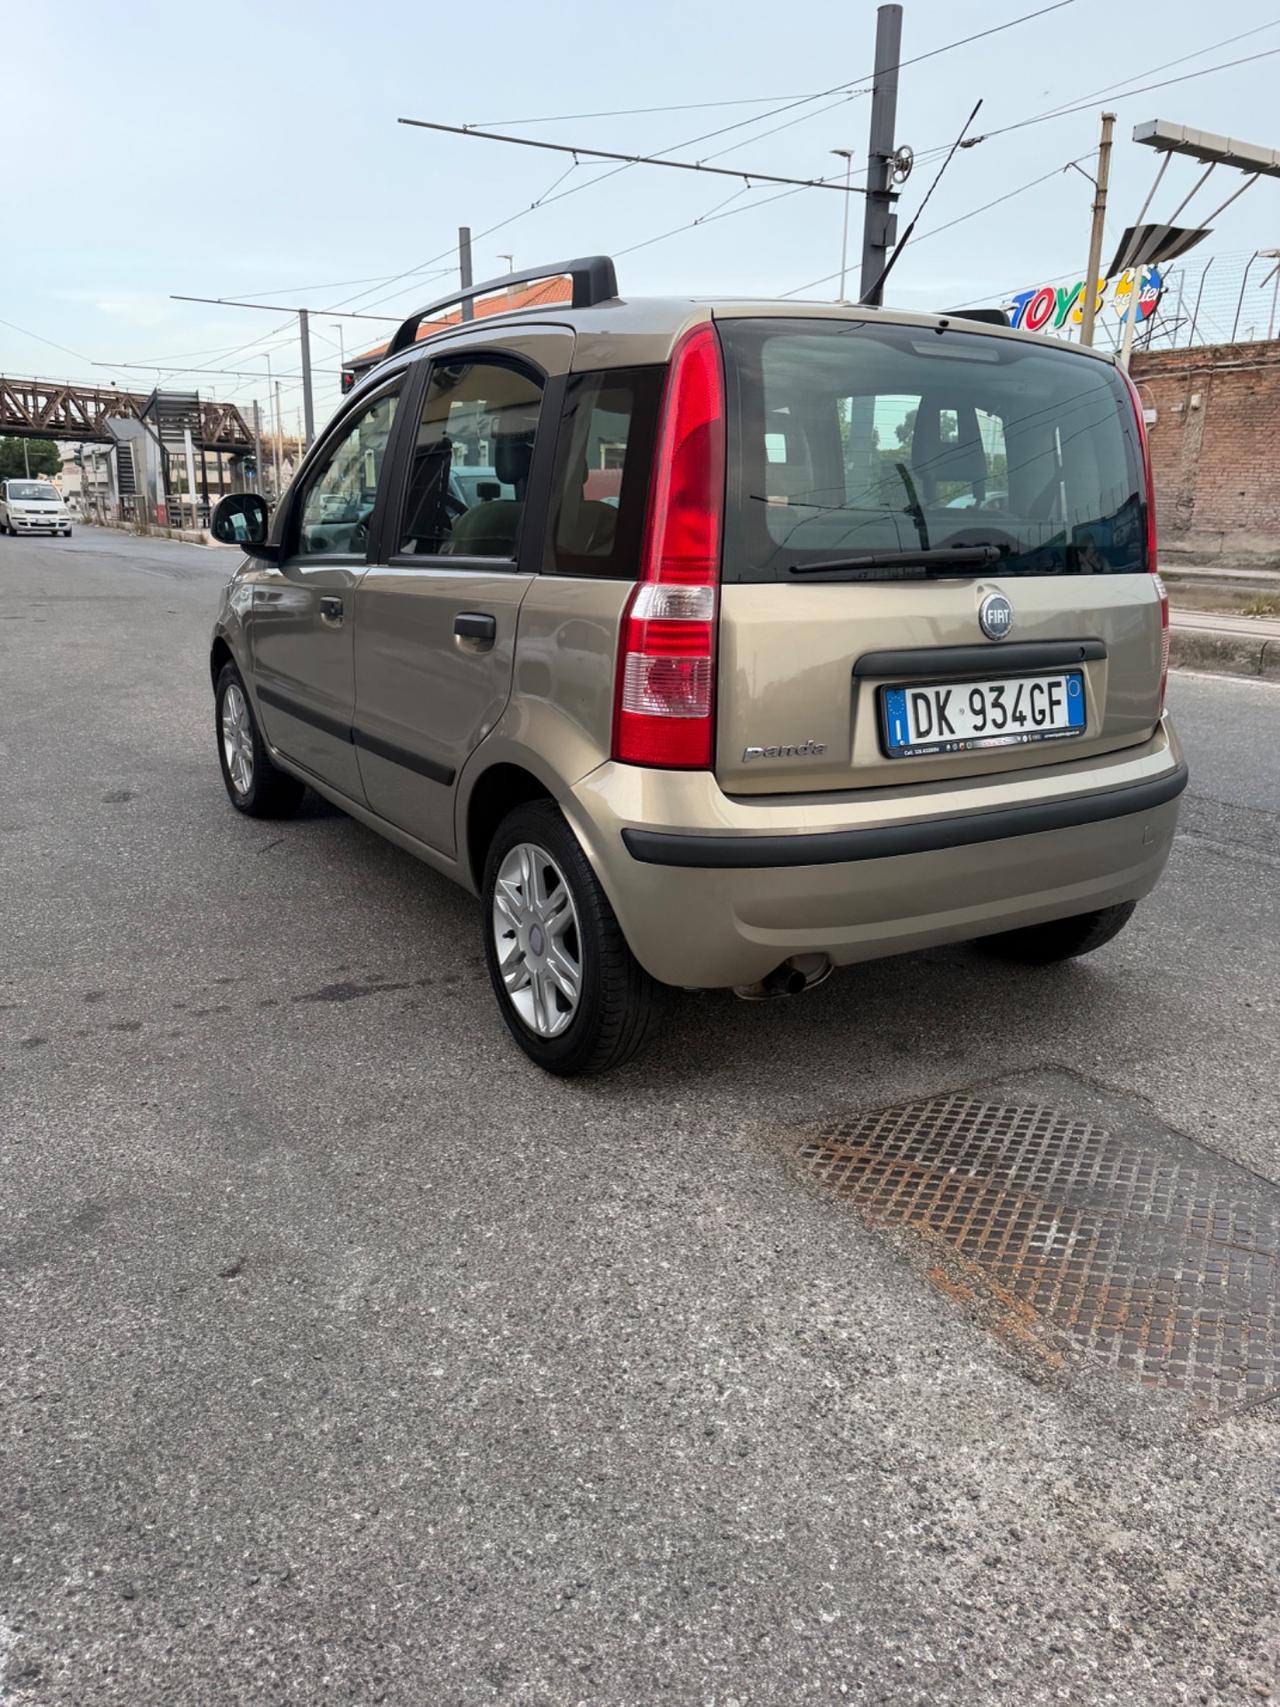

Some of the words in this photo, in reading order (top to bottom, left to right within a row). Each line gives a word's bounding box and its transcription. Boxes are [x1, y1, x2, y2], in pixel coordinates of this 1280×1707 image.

[1010, 278, 1107, 331] TOYS
[987, 609, 1010, 624] FIAT
[911, 689, 956, 739] DK
[968, 680, 1062, 732] 934GF
